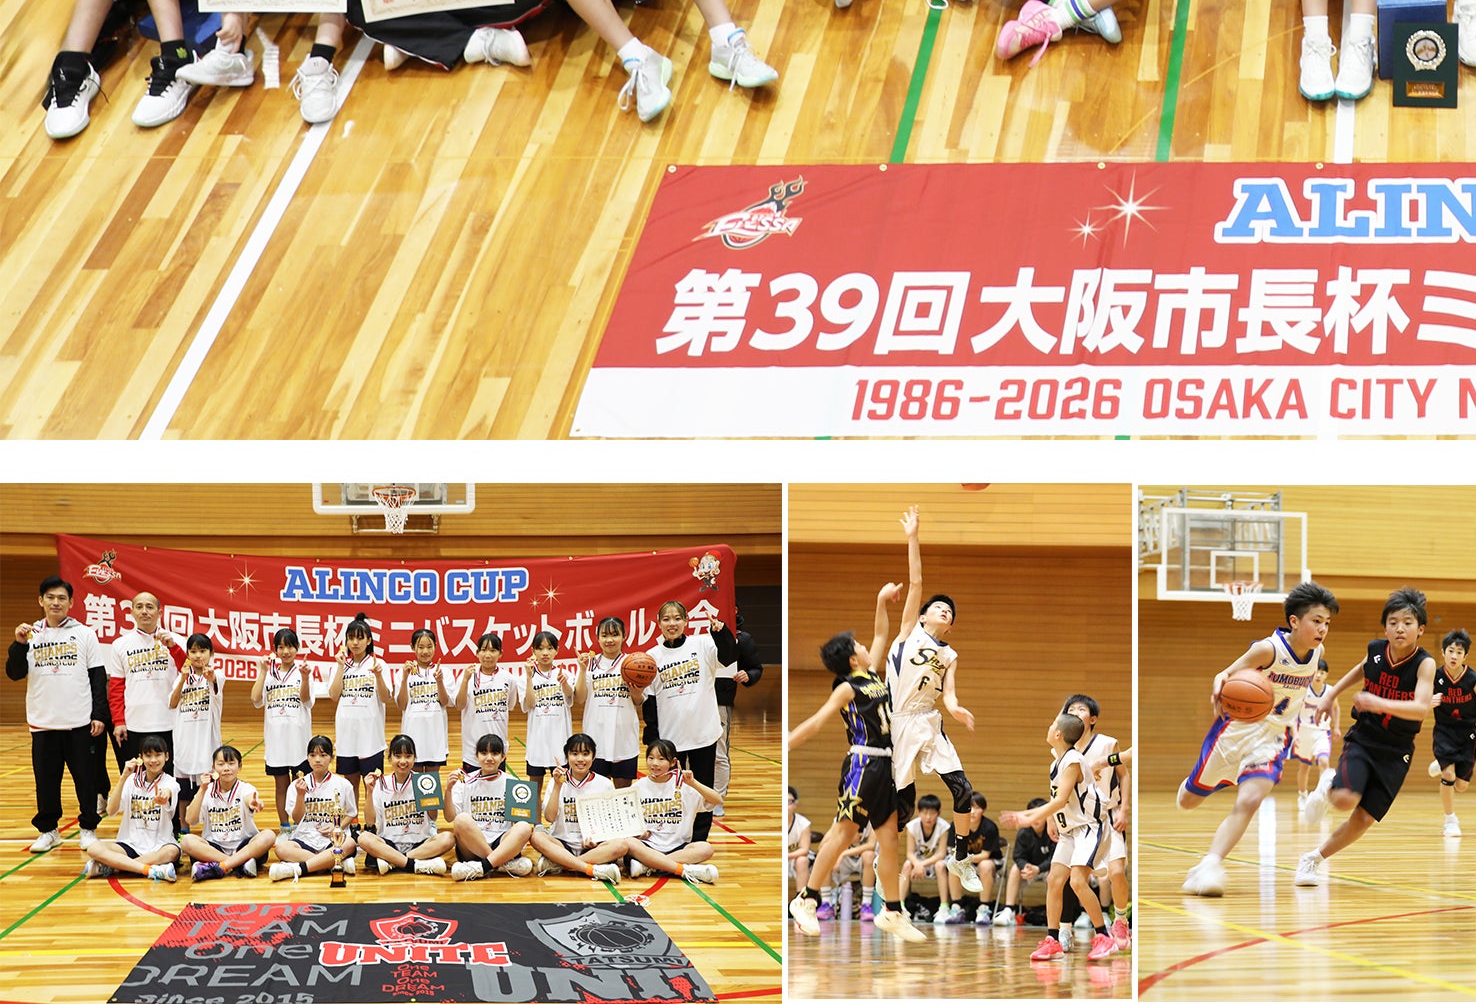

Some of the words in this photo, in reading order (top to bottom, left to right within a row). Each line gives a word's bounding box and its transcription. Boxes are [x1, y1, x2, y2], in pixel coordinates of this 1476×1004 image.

[851, 377, 1122, 422] 1986-2026
[1142, 376, 1310, 421] OSAKA
[1329, 376, 1434, 421] CITY
[280, 566, 439, 605] ALINCO
[447, 567, 529, 604] CUP
[33, 644, 77, 660] CHAMPS
[127, 650, 168, 667] CHAMPS
[658, 659, 699, 683] CHAMPS
[1379, 671, 1399, 689] RED
[1448, 687, 1463, 696] RED
[216, 903, 327, 917] One
[183, 920, 349, 937] TEAM
[184, 943, 314, 960] One
[319, 941, 514, 967] UNITE
[571, 955, 686, 965] TATSUMI
[123, 964, 364, 987] DREAM
[397, 963, 431, 971] One
[382, 984, 446, 992] DREAM
